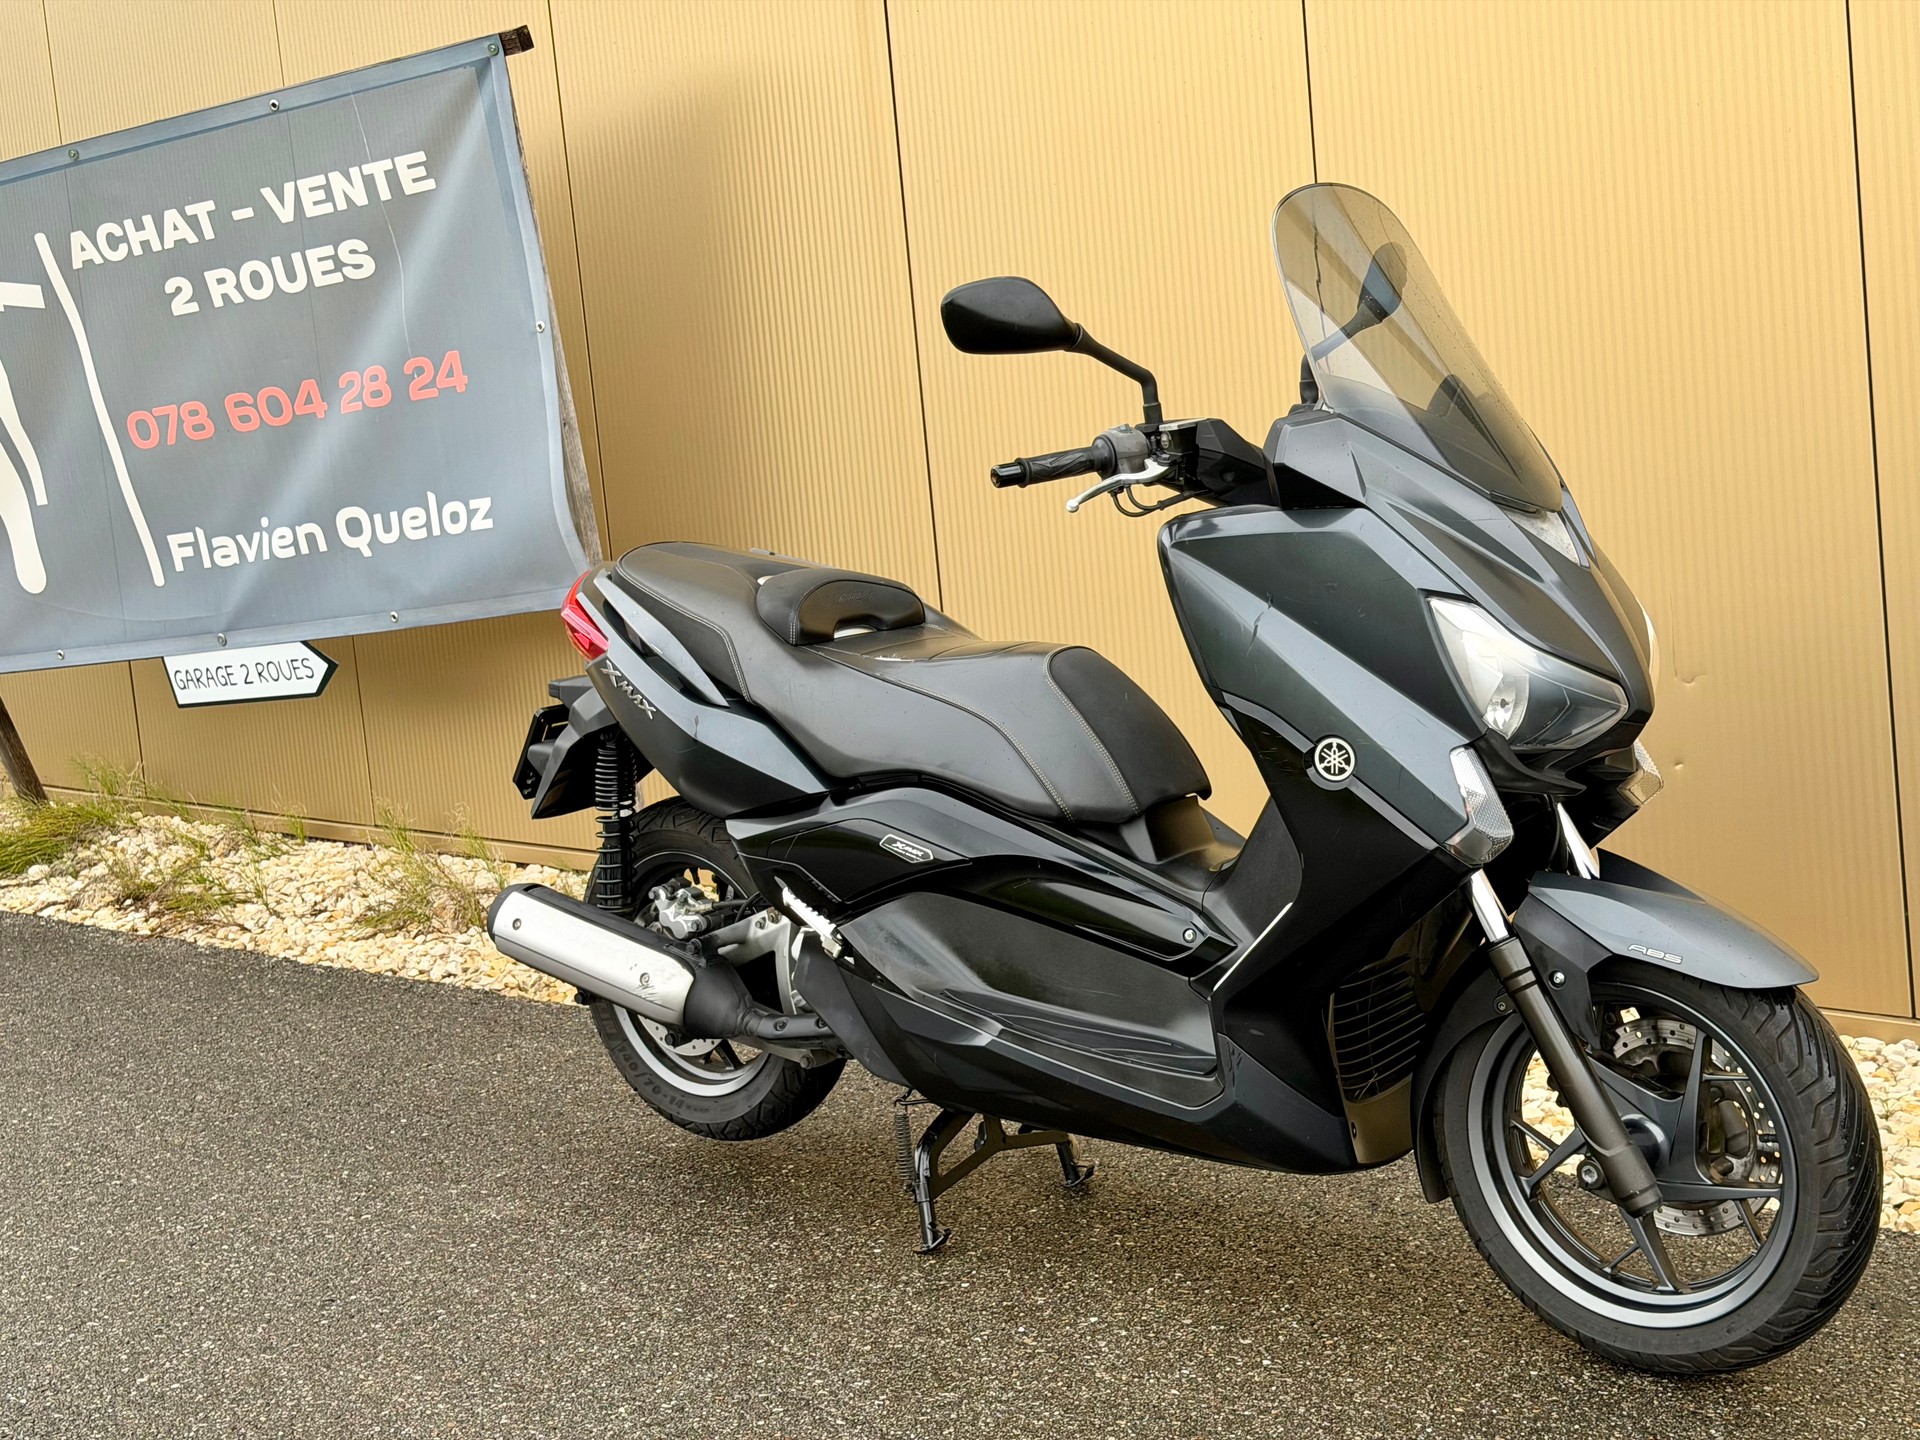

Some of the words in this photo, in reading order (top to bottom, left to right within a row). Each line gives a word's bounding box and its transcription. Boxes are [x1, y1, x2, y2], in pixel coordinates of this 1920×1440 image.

[69, 199, 216, 270] ACHAT
[231, 206, 255, 221] -
[259, 150, 437, 224] VENTE
[164, 276, 200, 317] 2
[203, 238, 376, 308] ROUES
[126, 401, 215, 449] 078
[224, 379, 328, 433] 604
[338, 365, 392, 414] 28
[403, 350, 468, 402] 24
[166, 516, 328, 572] Flavien
[335, 490, 494, 558] Queloz
[174, 664, 238, 690] GARAGE
[239, 663, 254, 685] 2
[255, 657, 315, 684] ROUES
[1627, 944, 1683, 965] ABS
